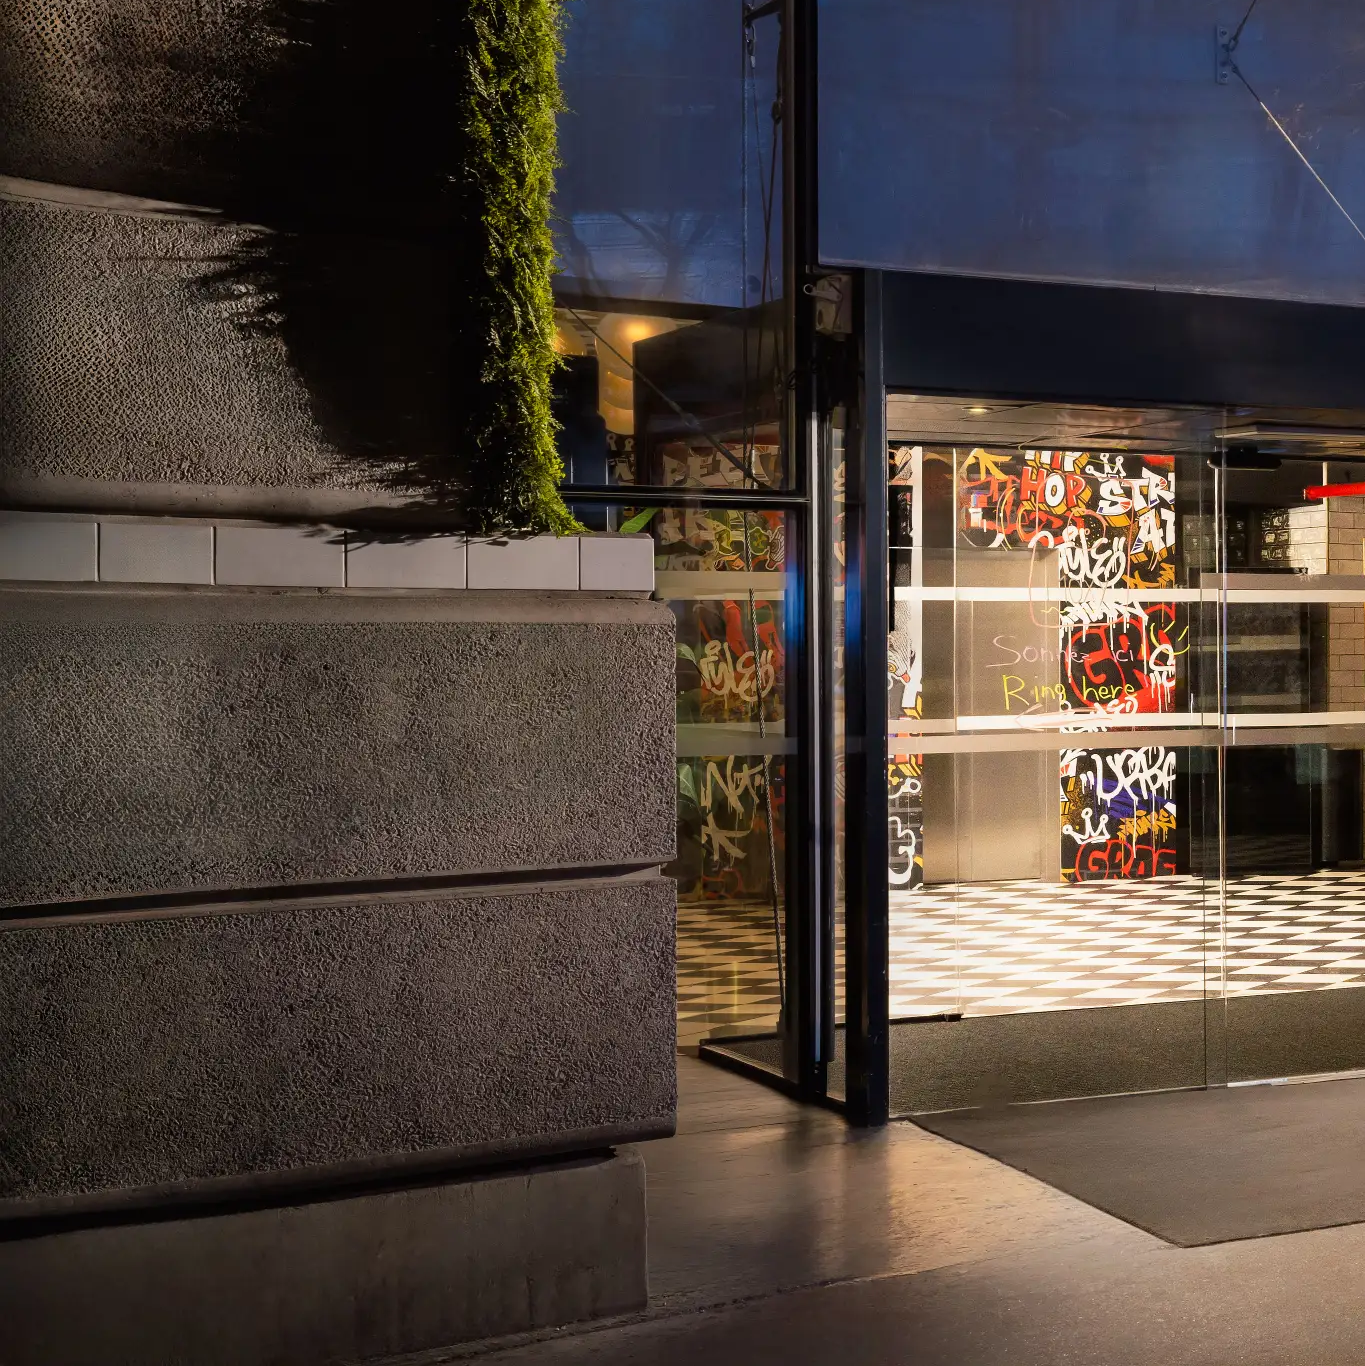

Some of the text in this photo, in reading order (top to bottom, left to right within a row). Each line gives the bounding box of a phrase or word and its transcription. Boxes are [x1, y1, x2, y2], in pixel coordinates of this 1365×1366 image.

[1020, 466, 1087, 509] HOP
[986, 635, 1094, 668] Sonnez
[1002, 674, 1138, 711] Ring here
